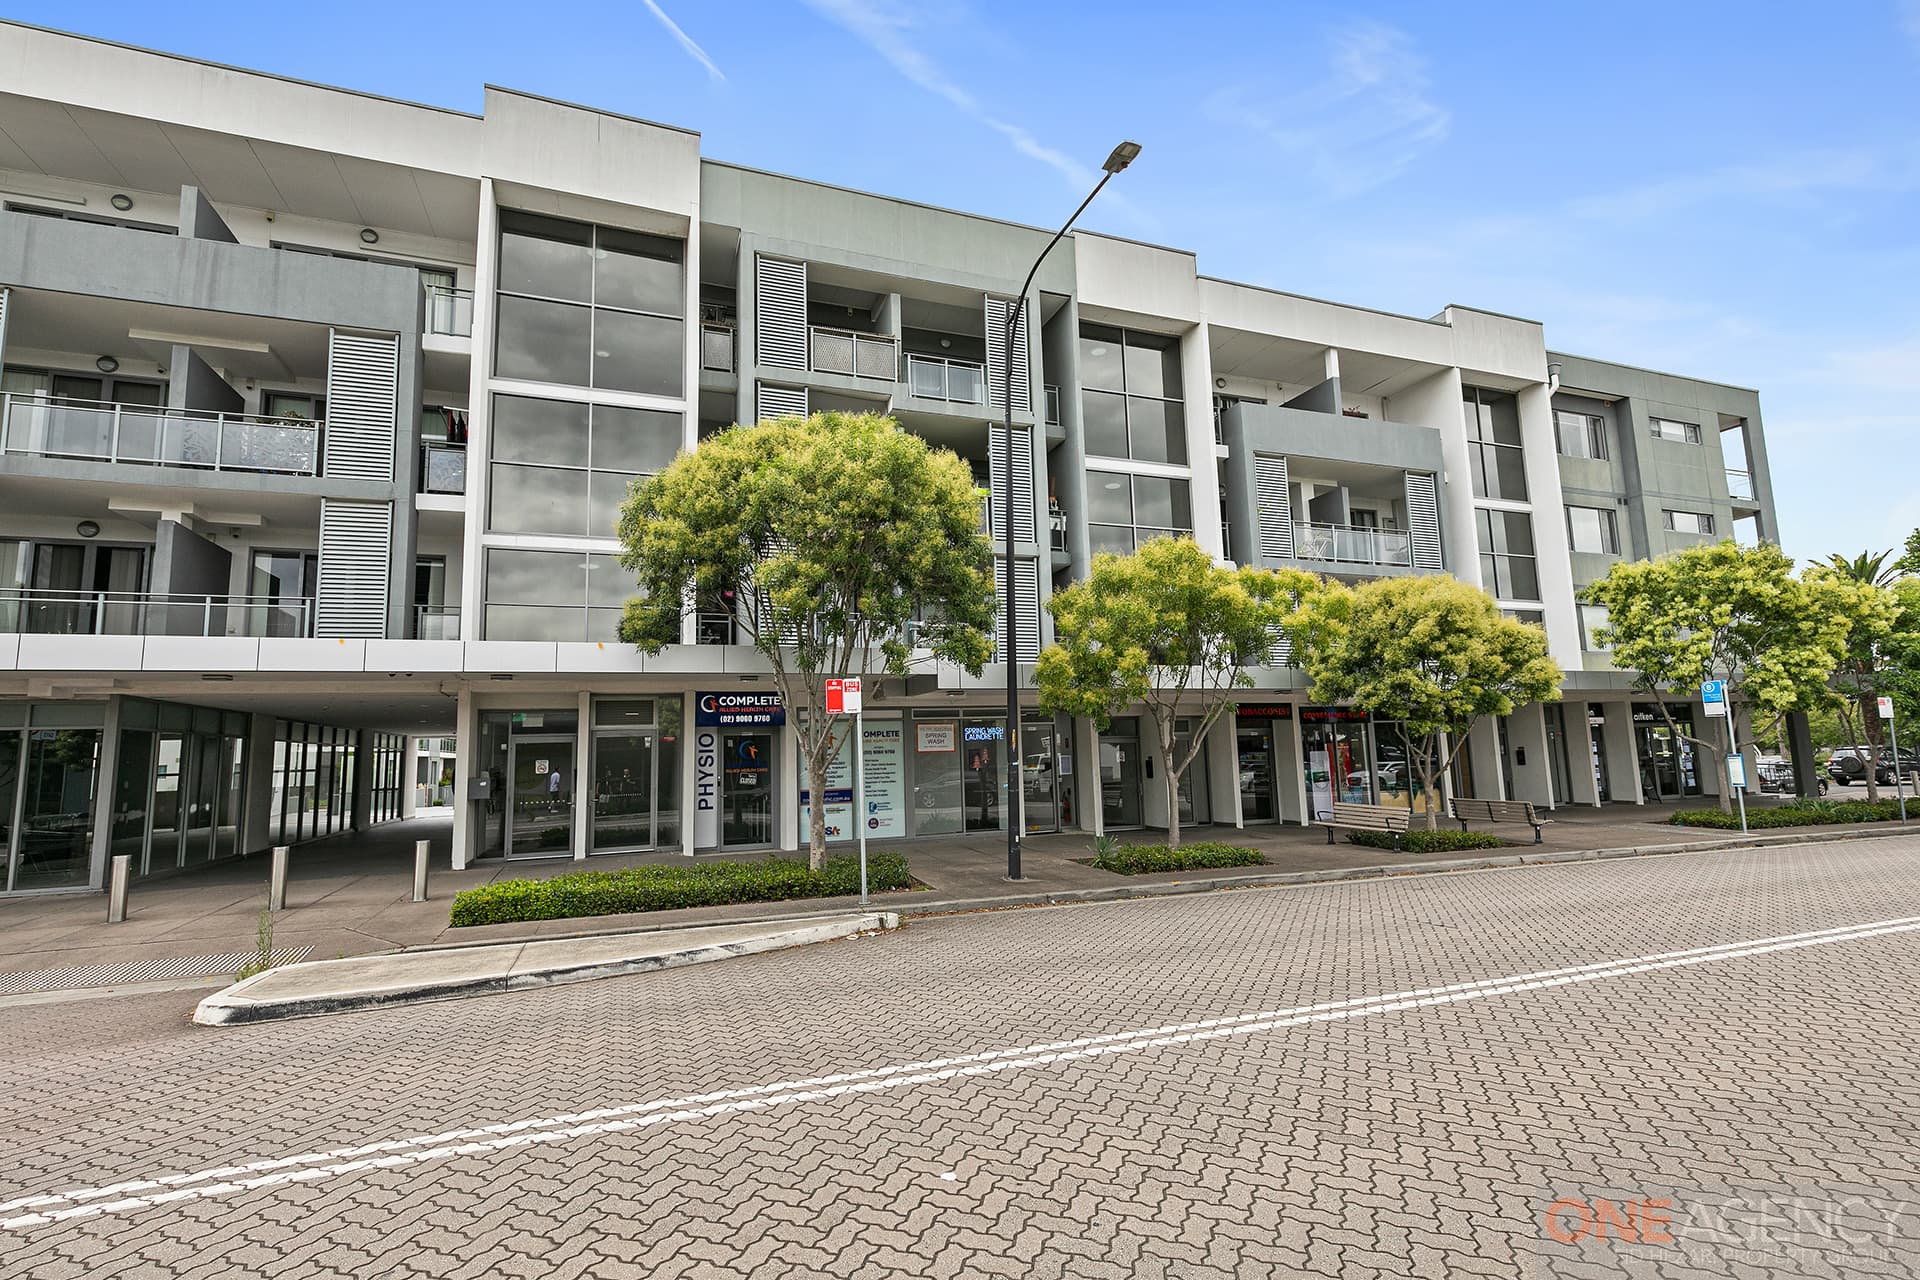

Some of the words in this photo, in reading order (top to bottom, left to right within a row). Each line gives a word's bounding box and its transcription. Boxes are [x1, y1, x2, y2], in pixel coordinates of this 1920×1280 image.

[719, 696, 780, 706] COMPLETE
[863, 730, 900, 738] OMPLETE
[964, 727, 986, 735] SPRING
[987, 727, 1004, 735] WASH
[698, 733, 714, 810] PHYSIO
